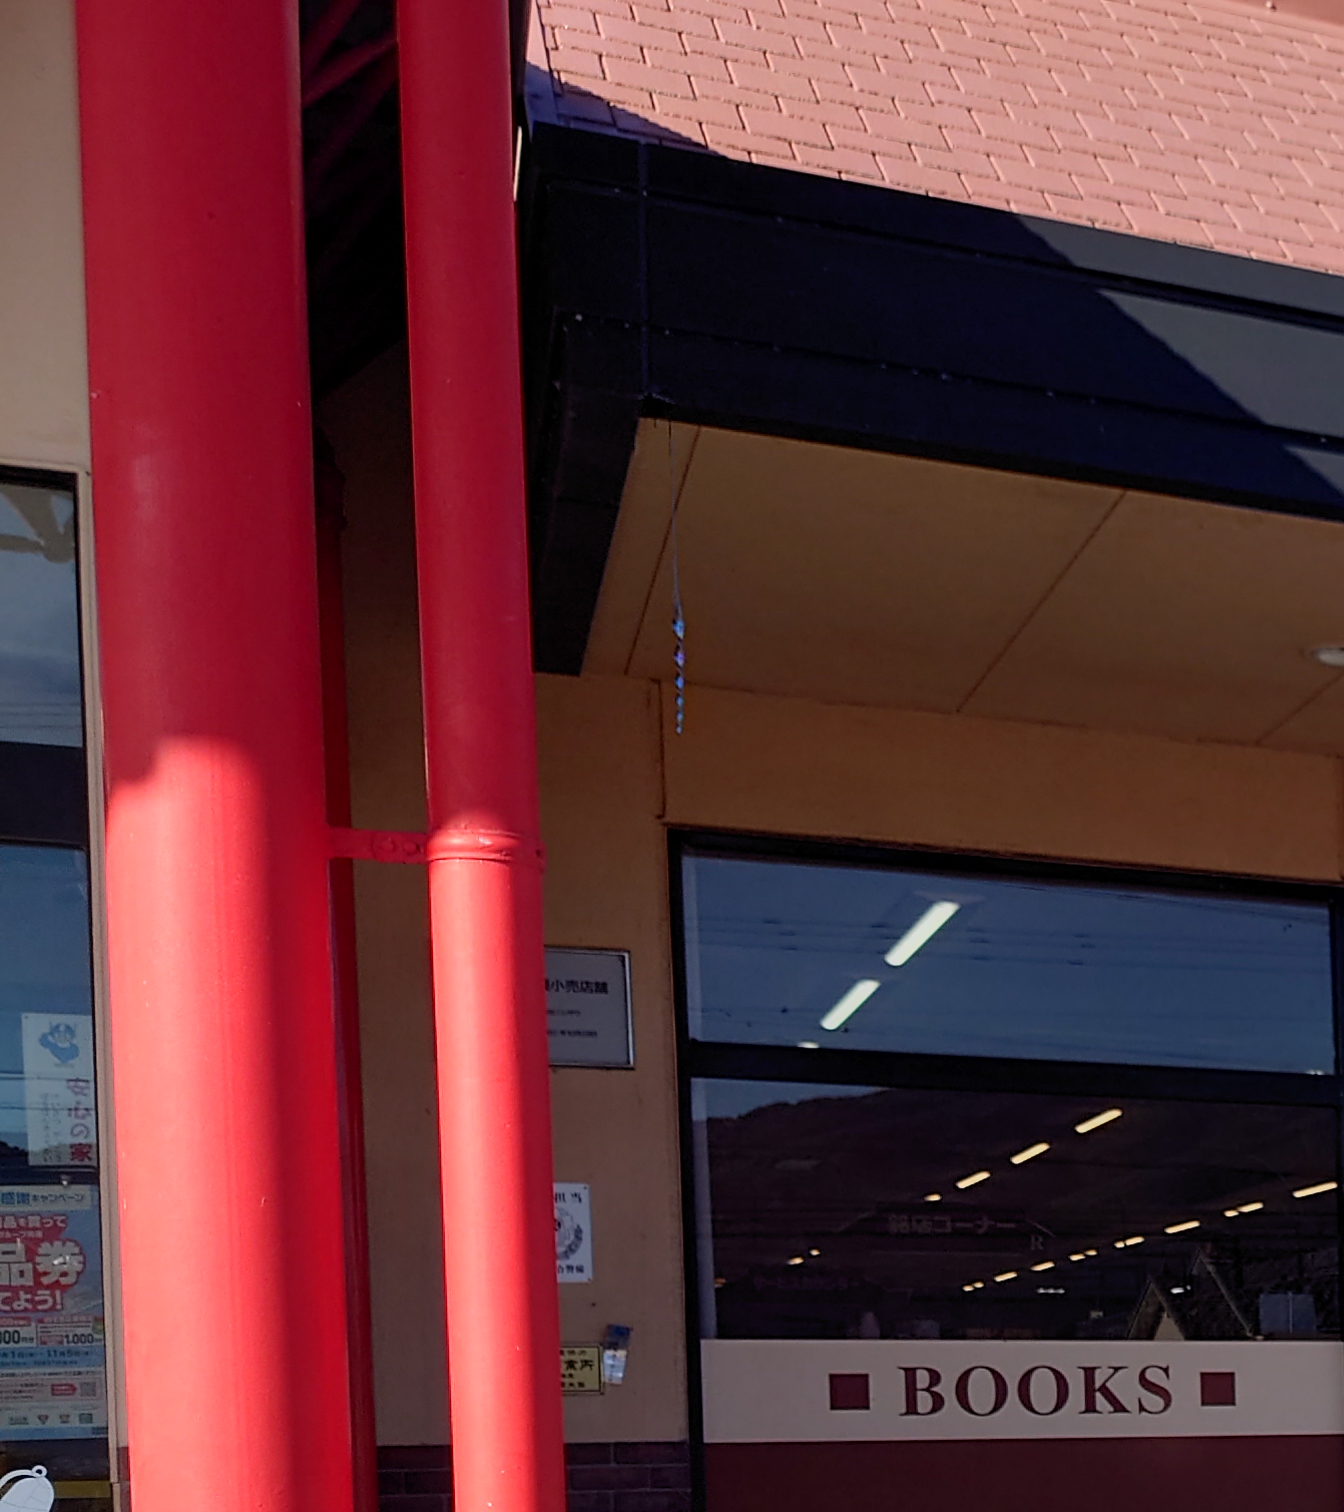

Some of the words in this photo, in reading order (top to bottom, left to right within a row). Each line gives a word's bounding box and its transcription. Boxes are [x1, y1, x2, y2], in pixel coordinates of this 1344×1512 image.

[0, 1215, 67, 1229] 品を買って
[898, 1365, 1172, 1417] BOOKS
